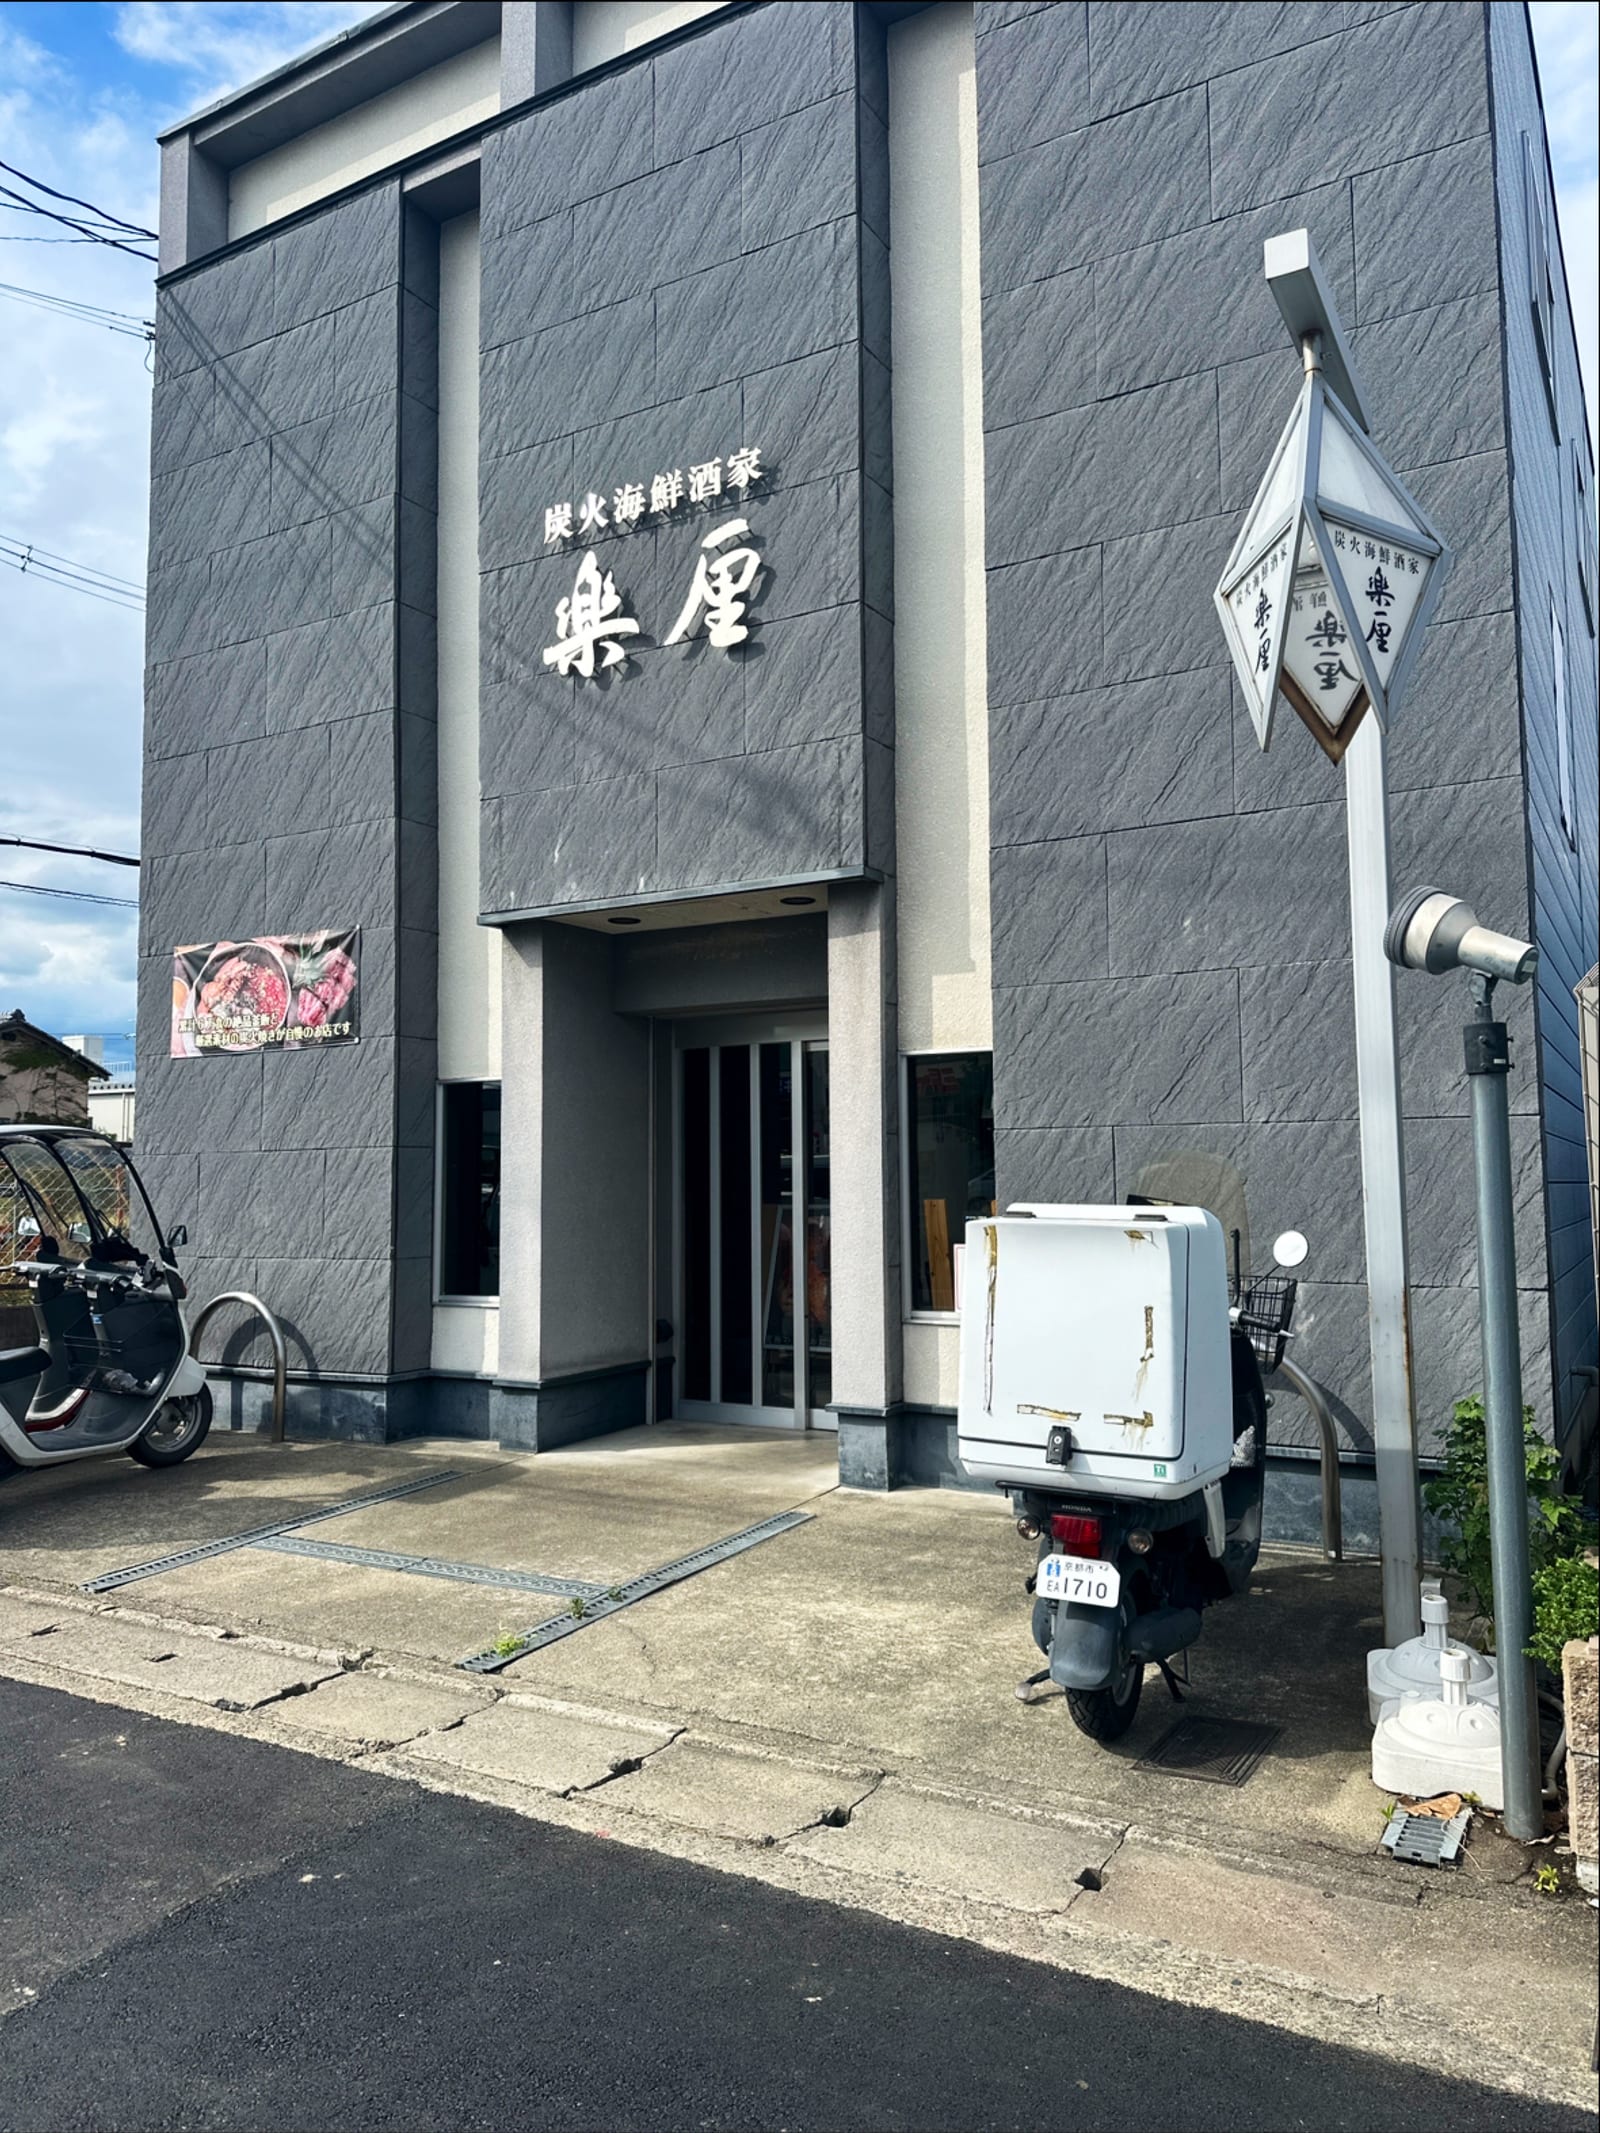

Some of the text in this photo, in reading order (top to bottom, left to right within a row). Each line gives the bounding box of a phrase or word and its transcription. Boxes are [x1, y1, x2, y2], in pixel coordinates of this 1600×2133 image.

[543, 447, 762, 544] 炭火海鮮酒家
[1334, 529, 1420, 575] 炭火海鮮酒家
[1061, 1504, 1092, 1513] HONDA
[1064, 1561, 1094, 1574] 京都市
[1063, 1576, 1108, 1600] 1710
